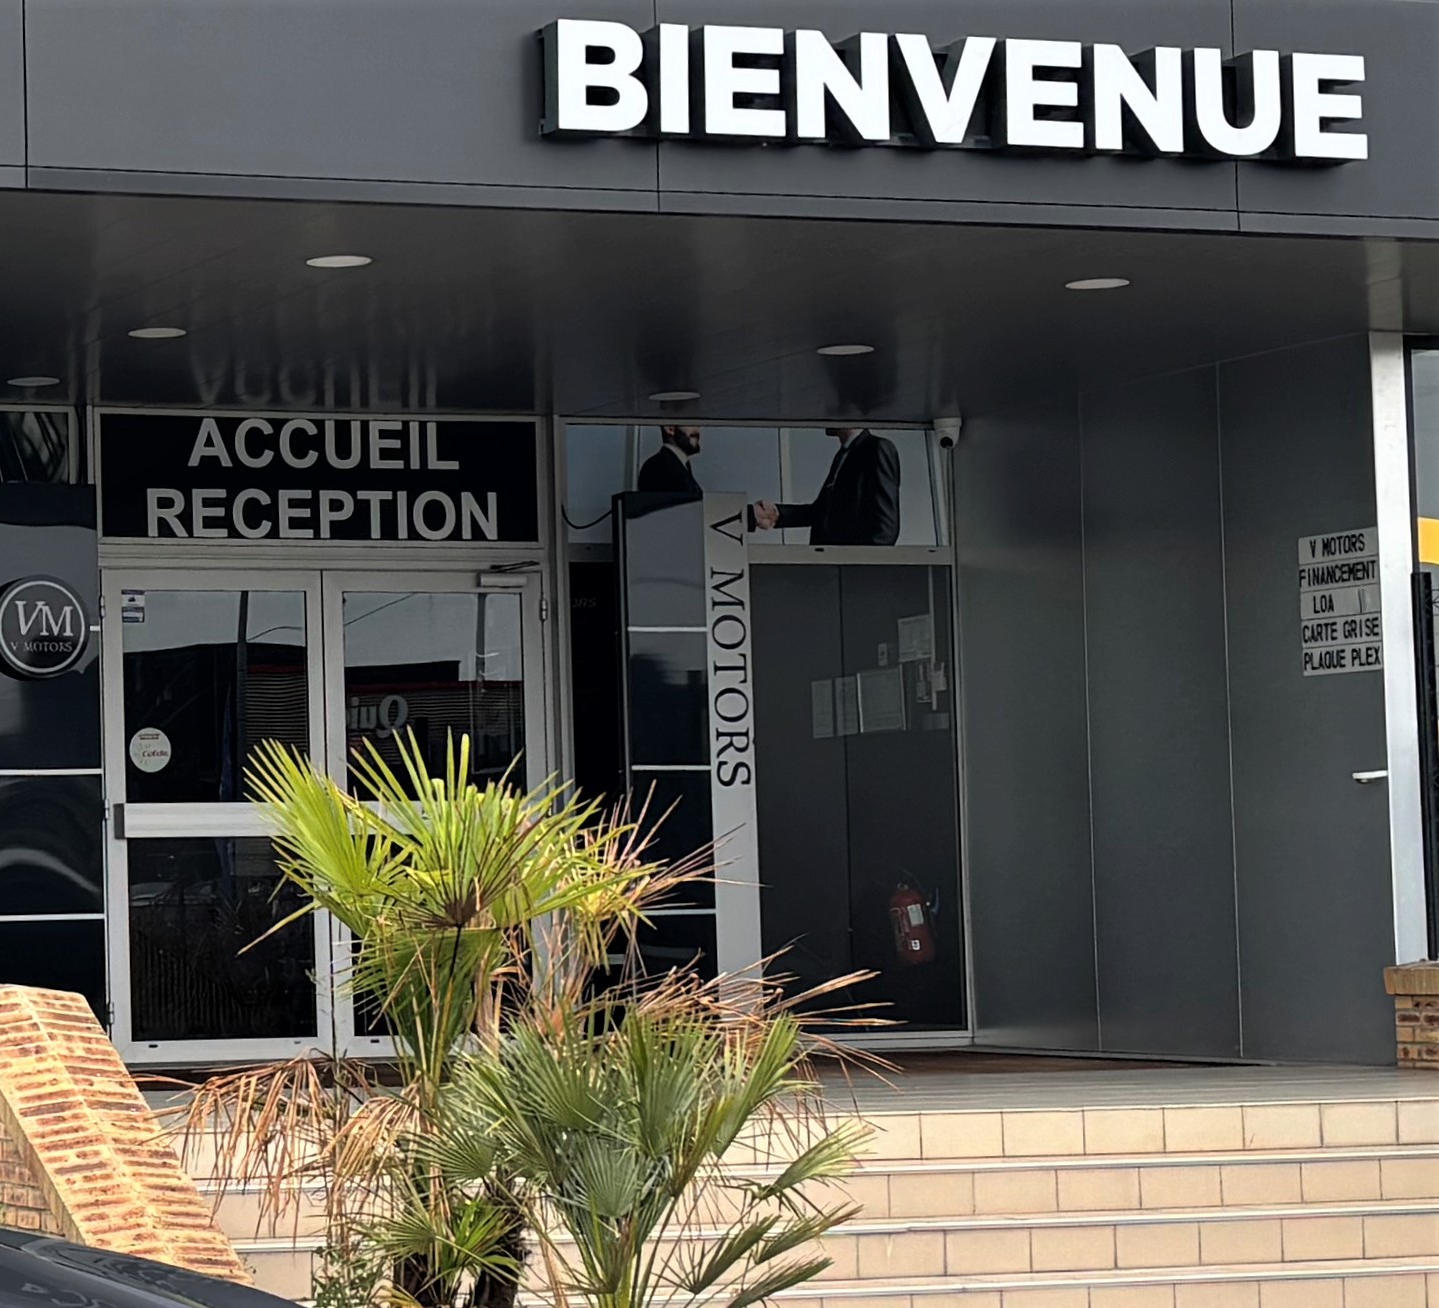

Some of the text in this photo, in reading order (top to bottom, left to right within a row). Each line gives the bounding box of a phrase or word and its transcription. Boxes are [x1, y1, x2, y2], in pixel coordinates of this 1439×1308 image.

[551, 18, 1370, 162] BIENVENUE
[187, 417, 460, 470] ACCUEIL
[146, 487, 499, 541] RECEPTION
[1310, 534, 1365, 558] V MOTORS
[1299, 561, 1376, 587] FINANCEMENT
[1312, 594, 1335, 614] LOA
[14, 600, 74, 637] VM
[1302, 618, 1379, 643] CARTE GRISE
[23, 641, 73, 653] MOTORS
[708, 509, 753, 788] V MOTORS
[1304, 649, 1345, 670] PLAQUE
